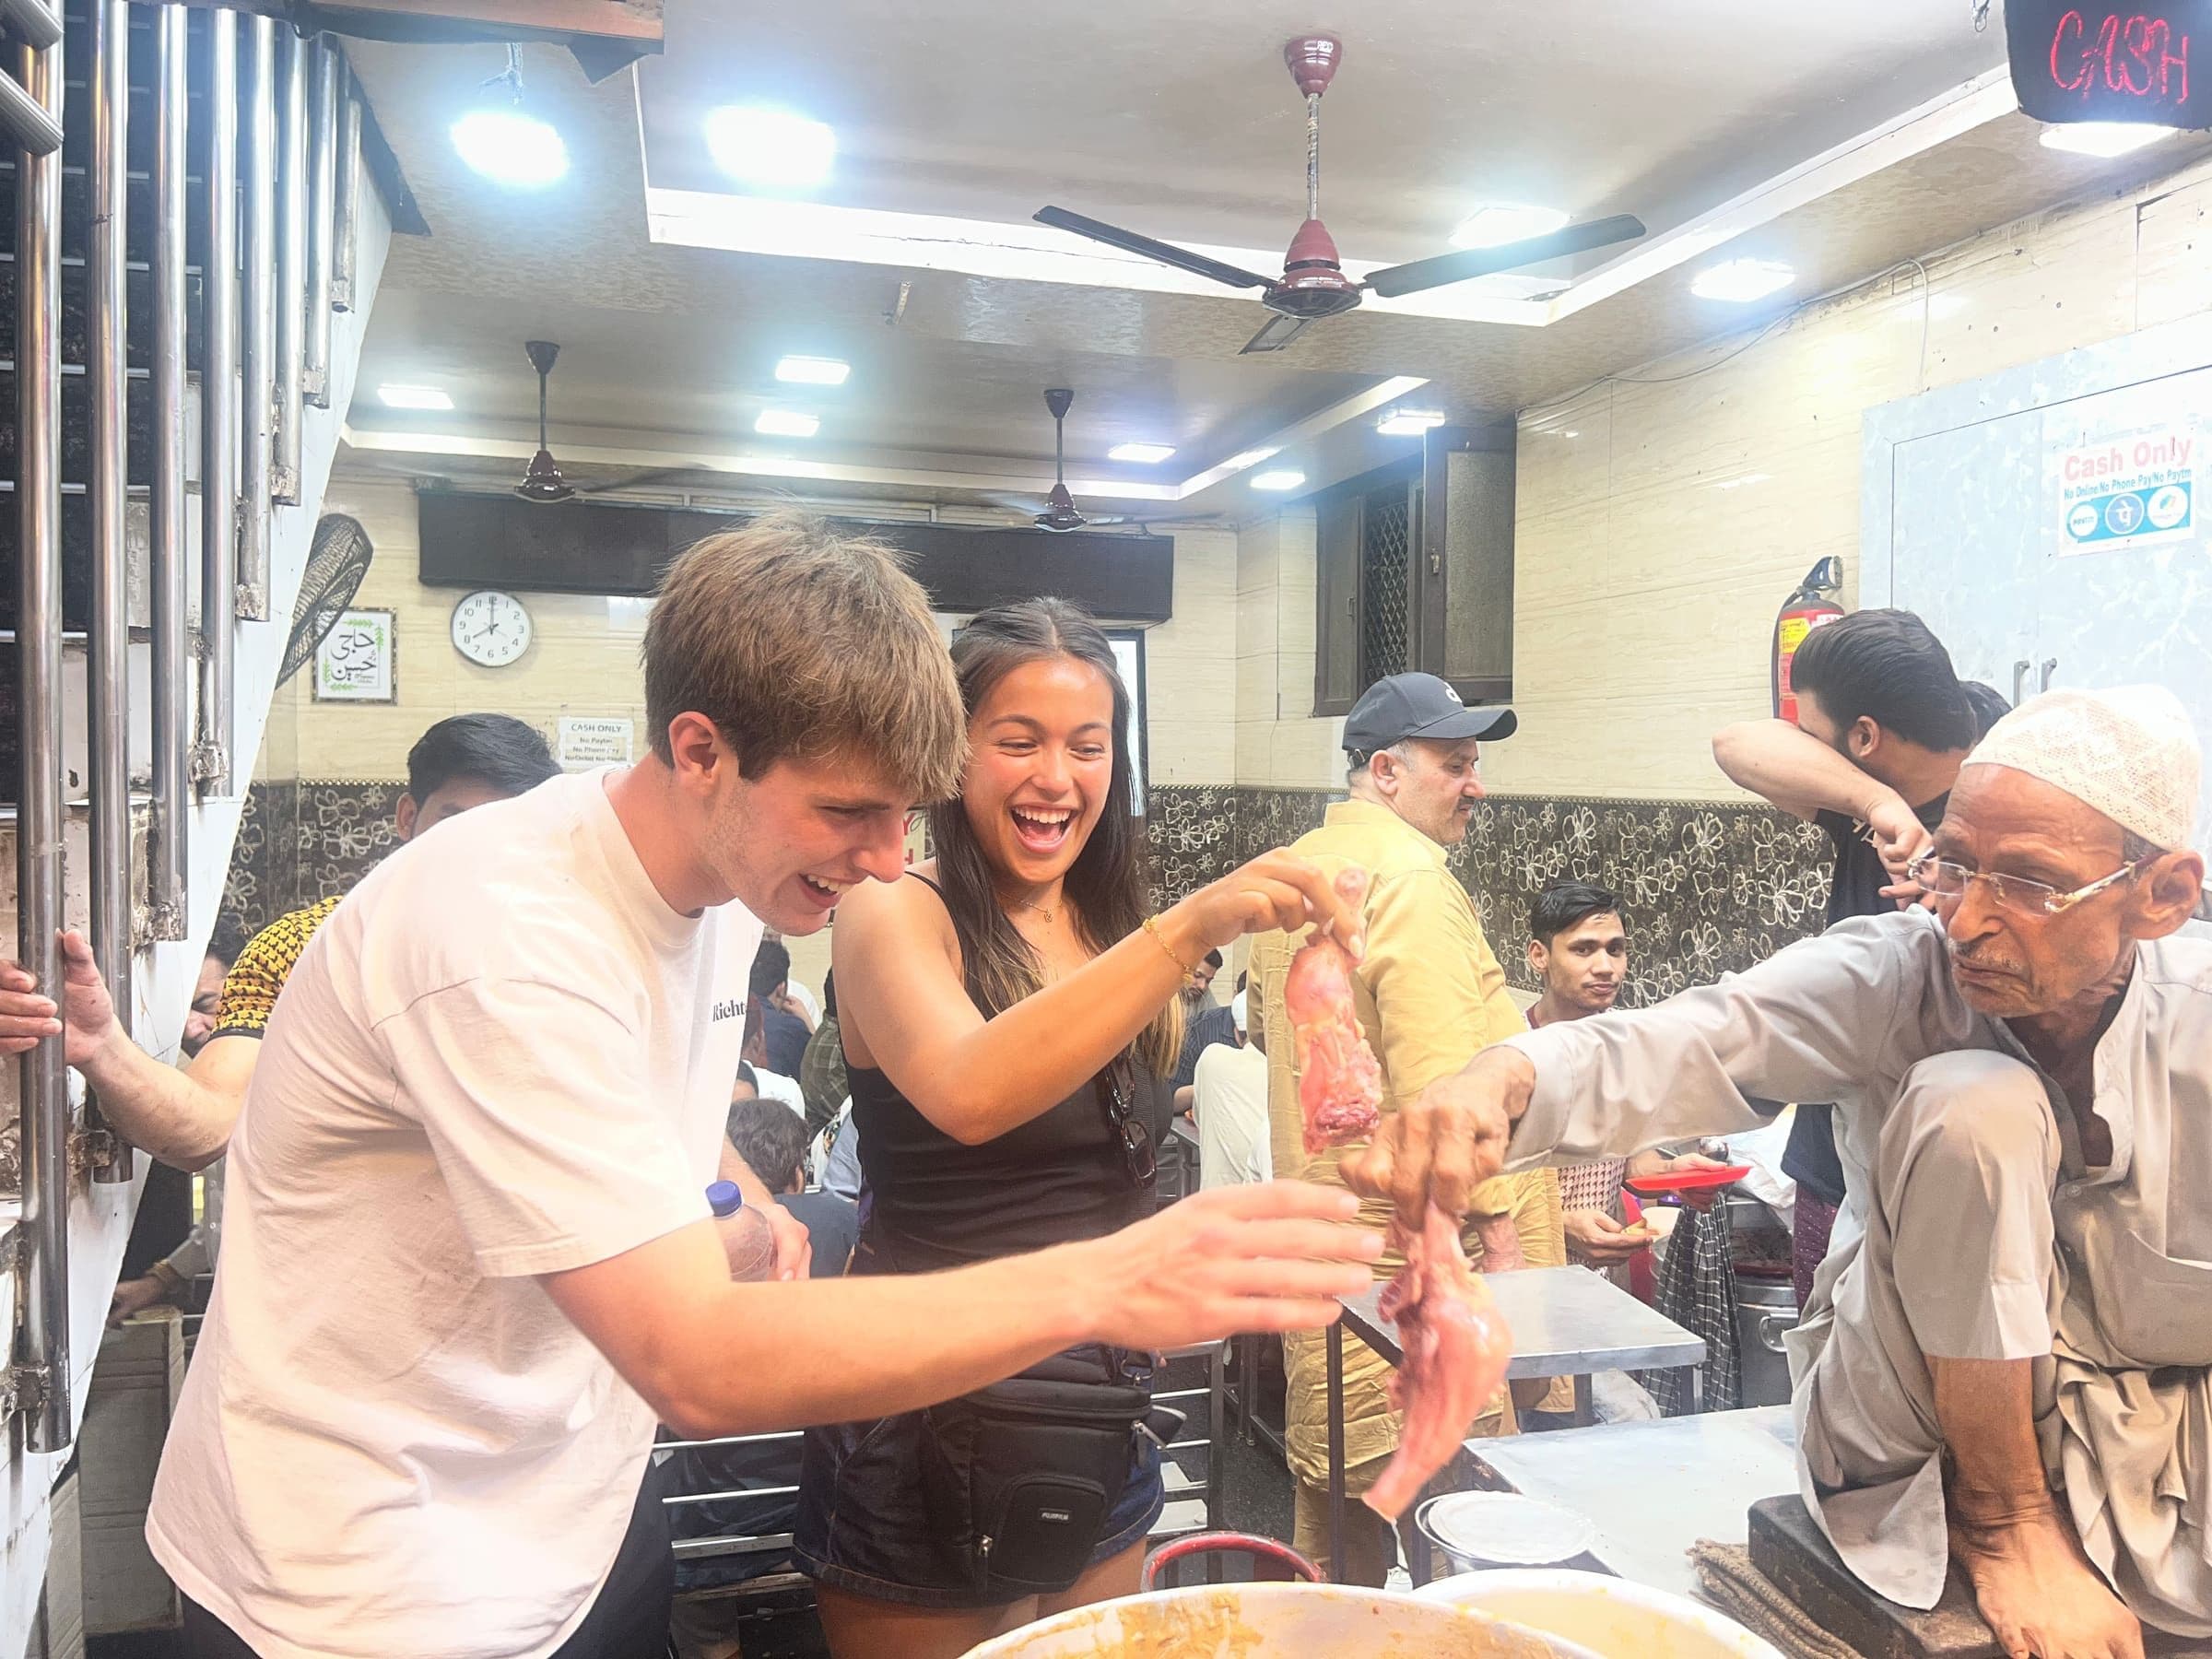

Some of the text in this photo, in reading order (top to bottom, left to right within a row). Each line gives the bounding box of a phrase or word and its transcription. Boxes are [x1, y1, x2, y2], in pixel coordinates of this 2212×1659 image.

[2051, 10, 2189, 104] CASH
[2065, 435, 2192, 481] Cash Only
[2065, 487, 2074, 500] No
[2112, 478, 2136, 490] Phone
[2168, 468, 2192, 483] Paytm
[465, 607, 475, 617] 10
[513, 611, 520, 620] 2
[459, 620, 466, 629] 9
[518, 625, 524, 634] 3
[512, 638, 518, 646] 4
[474, 645, 480, 653] 7
[488, 649, 494, 658] 6
[502, 646, 509, 655] 5
[571, 724, 621, 733] CASH ONLY
